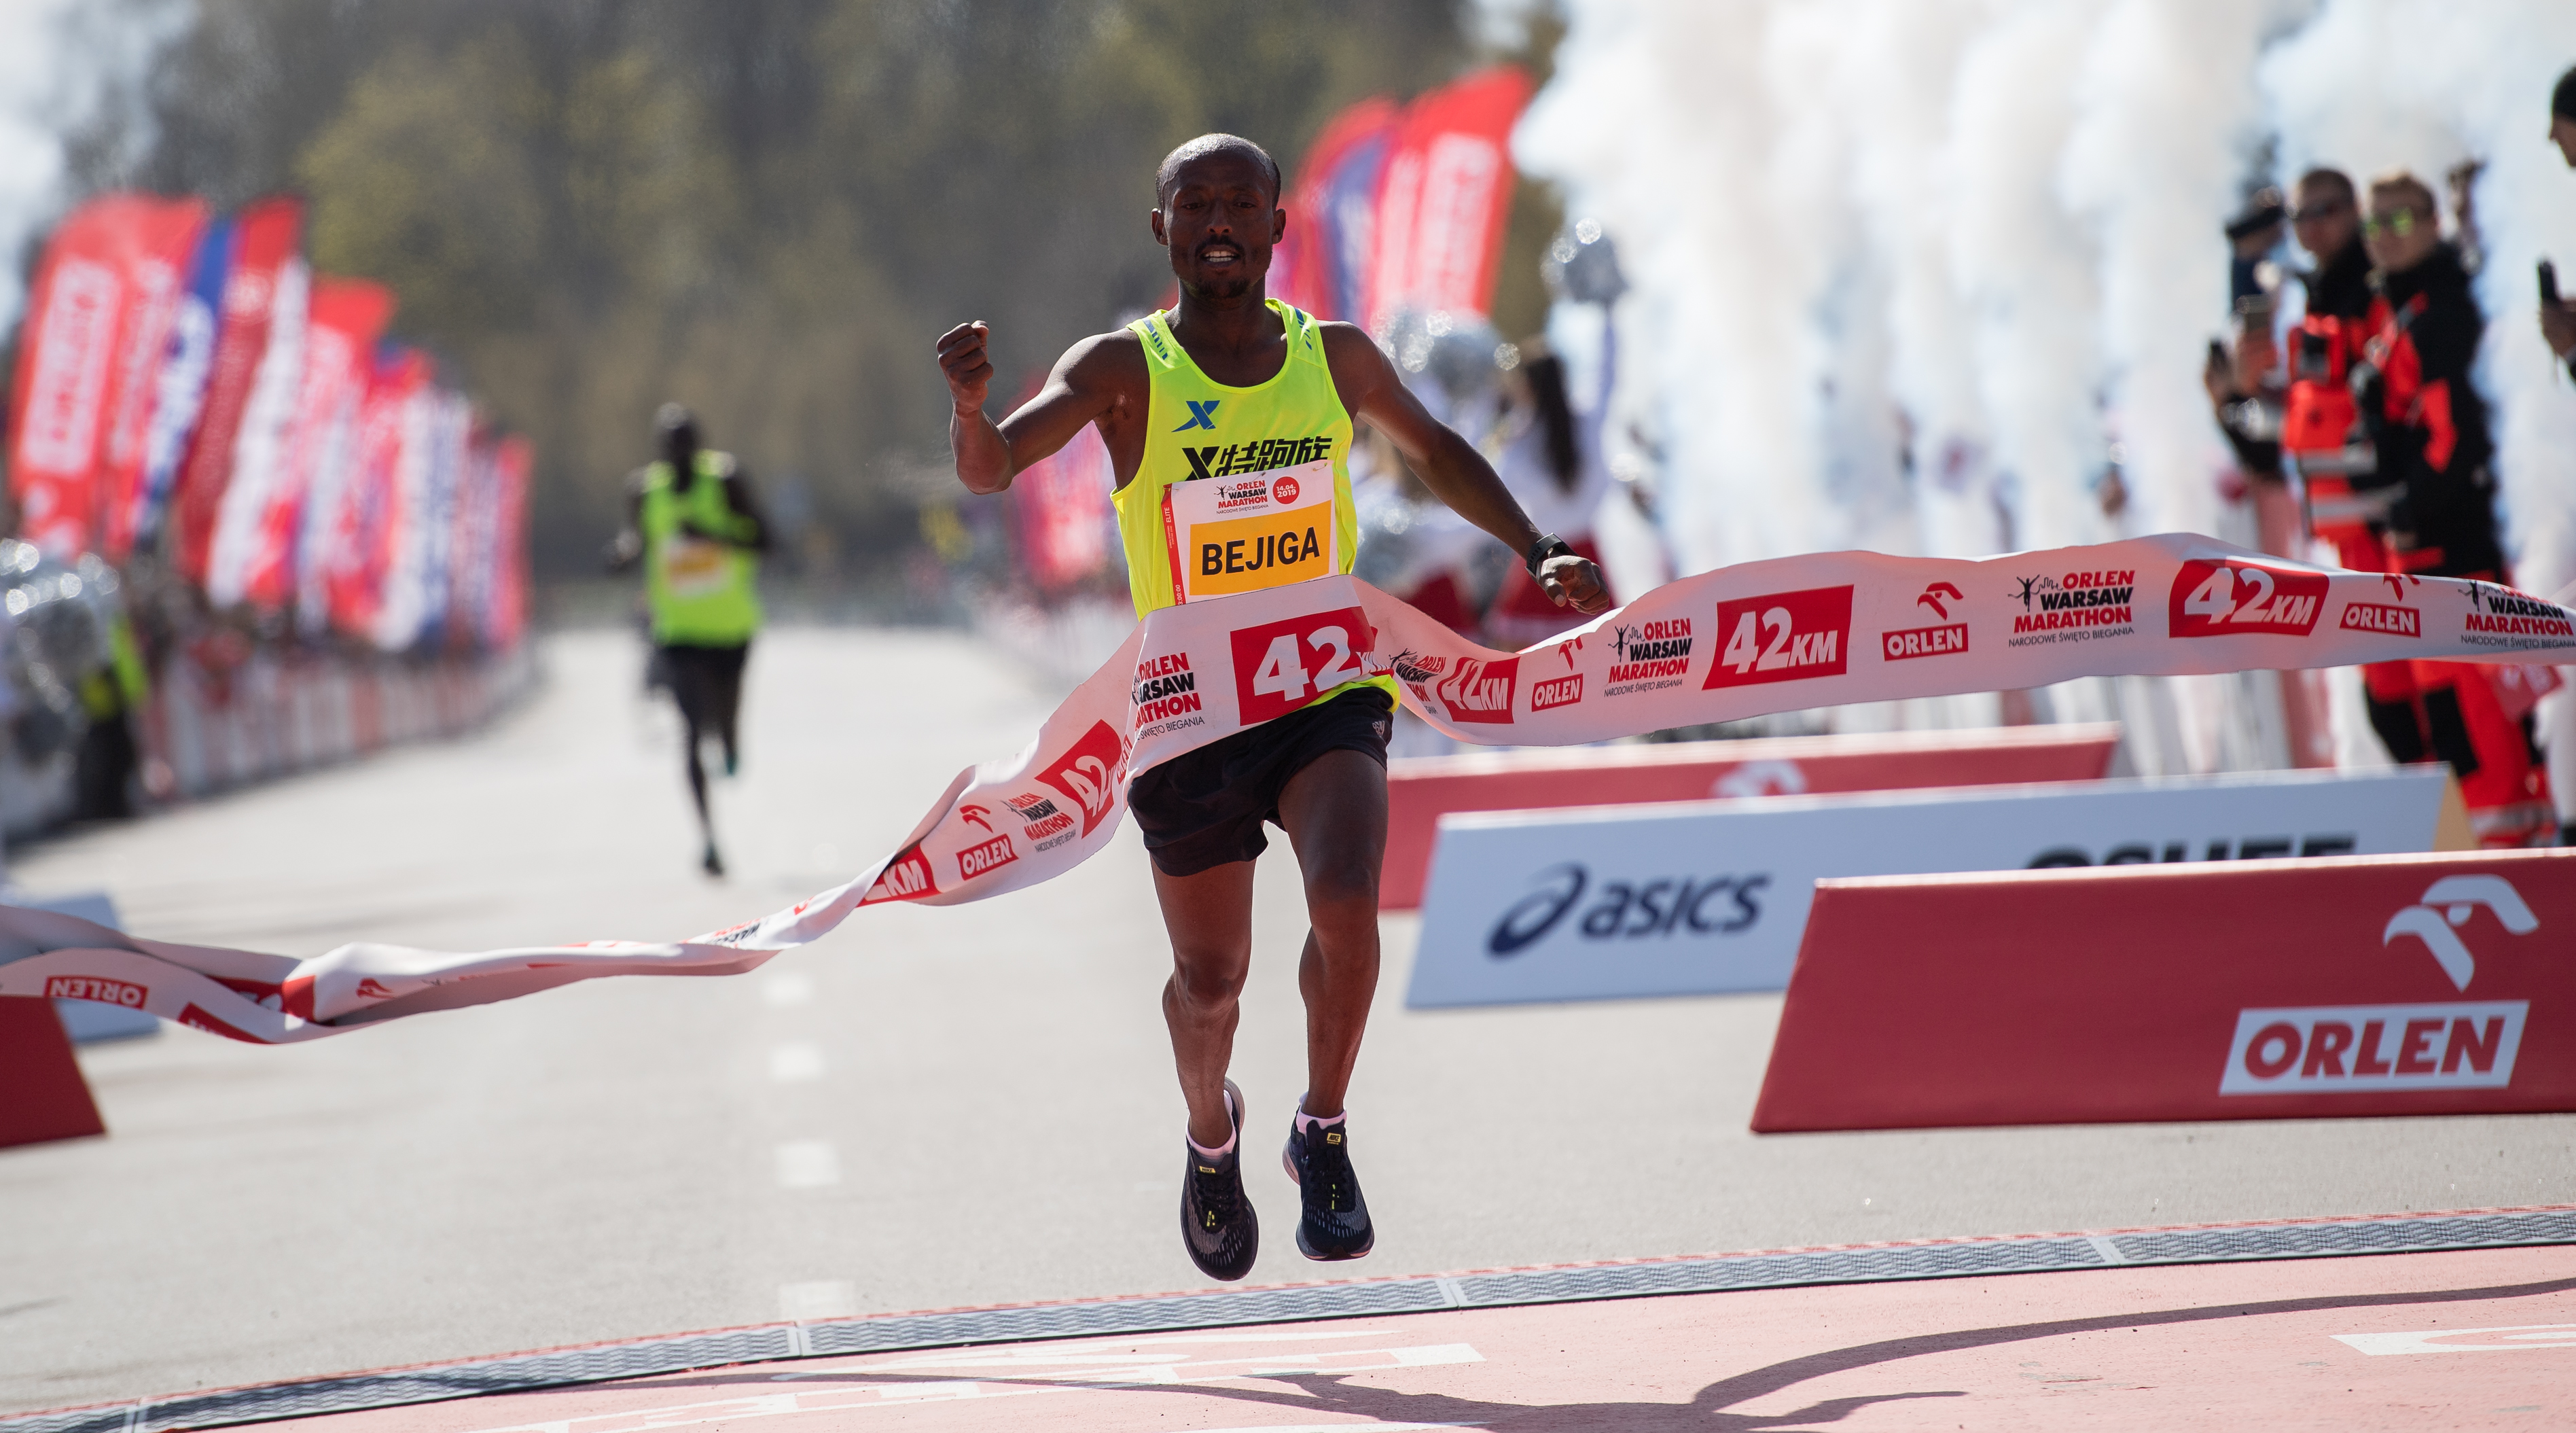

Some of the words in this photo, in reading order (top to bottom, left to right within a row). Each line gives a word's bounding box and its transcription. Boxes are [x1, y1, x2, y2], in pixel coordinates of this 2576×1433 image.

[1228, 487, 1267, 499] WARSAW
[1236, 480, 1266, 491] ORLEN
[1277, 489, 1297, 498] 2019
[1218, 495, 1268, 508] MARATHON
[1202, 527, 1320, 576] BEJIGA
[2062, 570, 2135, 590] ORLEN
[2040, 586, 2134, 611] WARSAW
[2488, 596, 2566, 619] WARSAW
[1644, 618, 1692, 641] ORLEN
[2014, 605, 2132, 633] MARATHON
[2345, 605, 2416, 633] ORLEN
[2465, 612, 2574, 636] MARATHON
[1630, 637, 1693, 662] WARSAW
[1722, 606, 1838, 675] 42KM
[1887, 626, 1963, 656] ORLEN
[2009, 633, 2056, 648] NARODOWE
[2059, 631, 2090, 643] ŚWIĘTO
[2093, 626, 2134, 639] BIEGANIA
[2461, 634, 2508, 648] NARODOWE
[2511, 635, 2539, 650] ŚWIĘTO
[1139, 652, 1190, 682] ORLEN
[1608, 658, 1689, 684] MARATHON
[1535, 678, 1581, 707] ORLEN
[1604, 684, 1634, 697] NARODOWE
[1634, 681, 1656, 692] ŚWIĘTO
[1656, 679, 1683, 689] BIEGANIA
[1166, 716, 1205, 732] BIEGANIA
[1024, 812, 1075, 841] MARATHON
[962, 838, 1012, 875] ORLEN
[50, 978, 141, 1005] ORLEN
[2244, 1015, 2507, 1081] ORLEN
